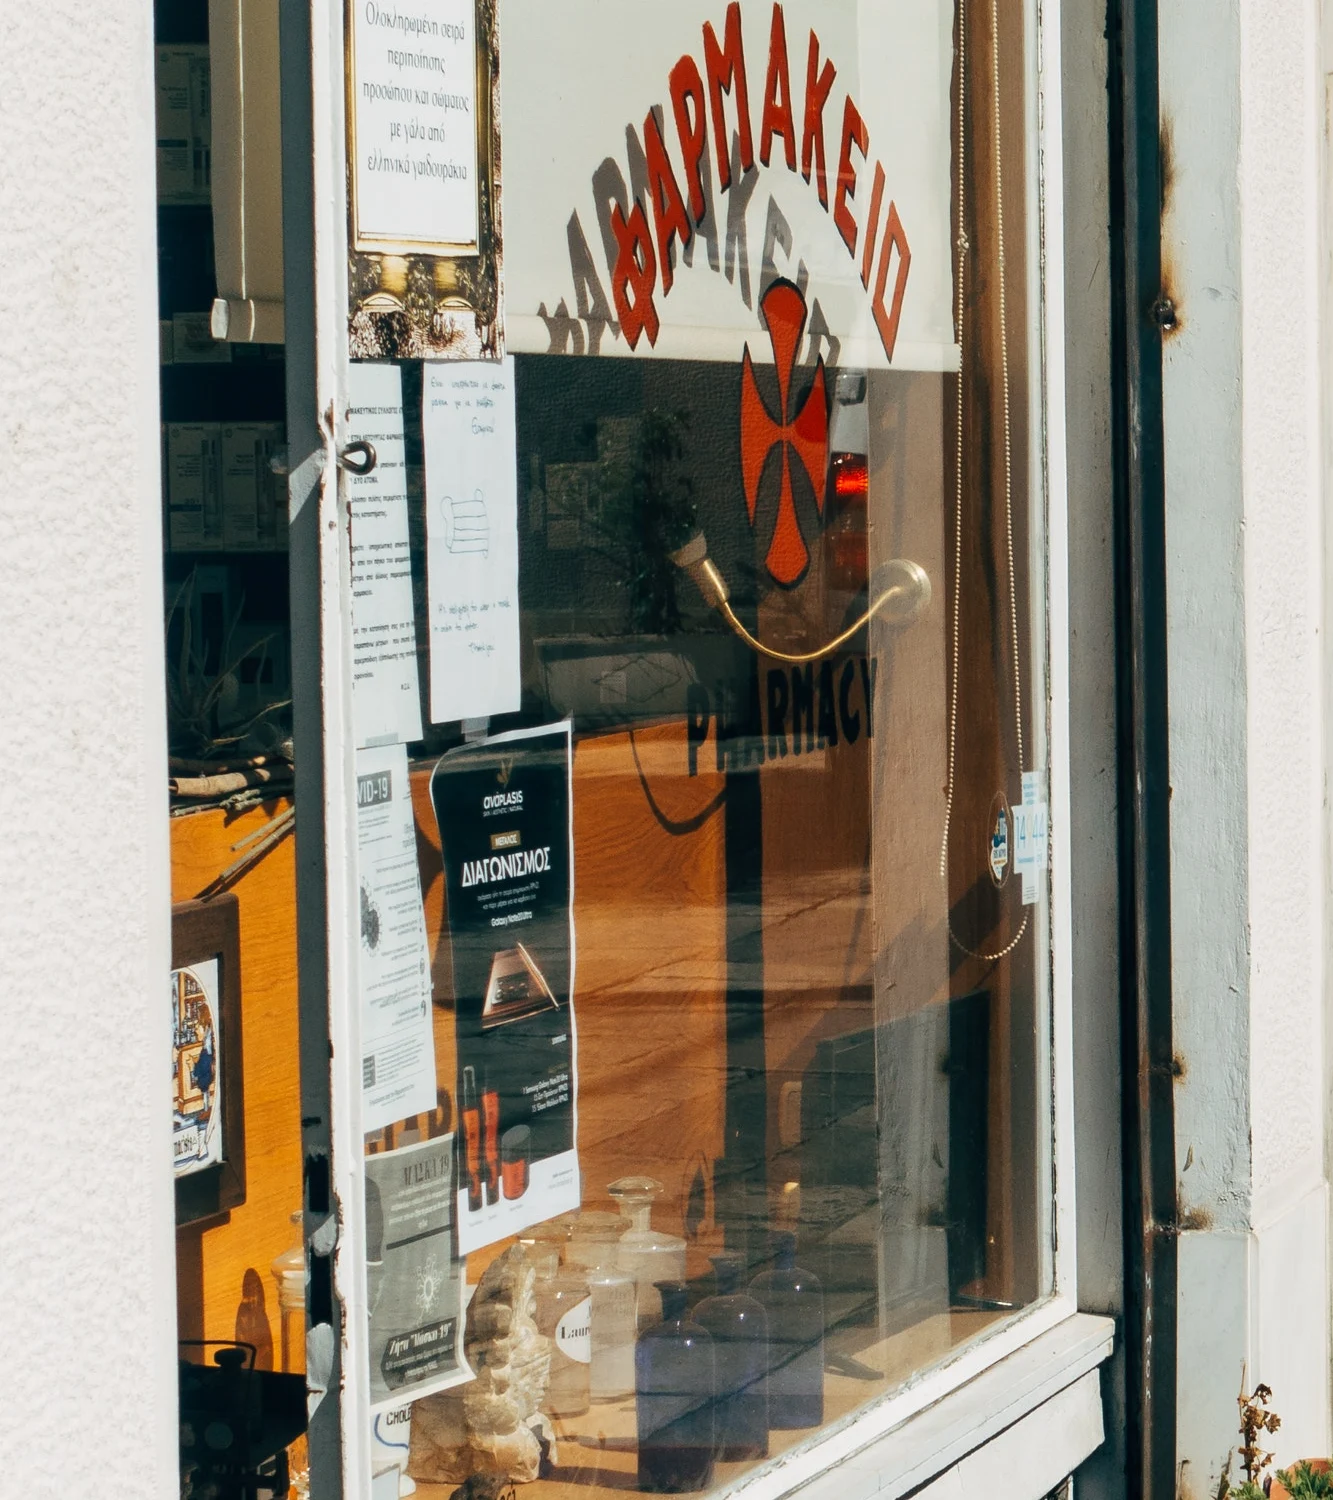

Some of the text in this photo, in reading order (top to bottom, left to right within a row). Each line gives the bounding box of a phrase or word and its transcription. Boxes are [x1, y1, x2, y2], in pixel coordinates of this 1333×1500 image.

[365, 1, 465, 45] Ολοκληρωμένη σειρά
[387, 48, 446, 74] περιποίησης
[362, 80, 469, 113] προσώπου και σώματος
[390, 117, 445, 144] με γάλα από
[367, 148, 410, 174] ελληνικά
[611, 1, 911, 364] ΦΑΡΜΑΚΕΙΟ
[687, 656, 878, 779] PHARMACY
[461, 846, 551, 888] ΔΙΑΓΩΝΙΣΜΟΣ
